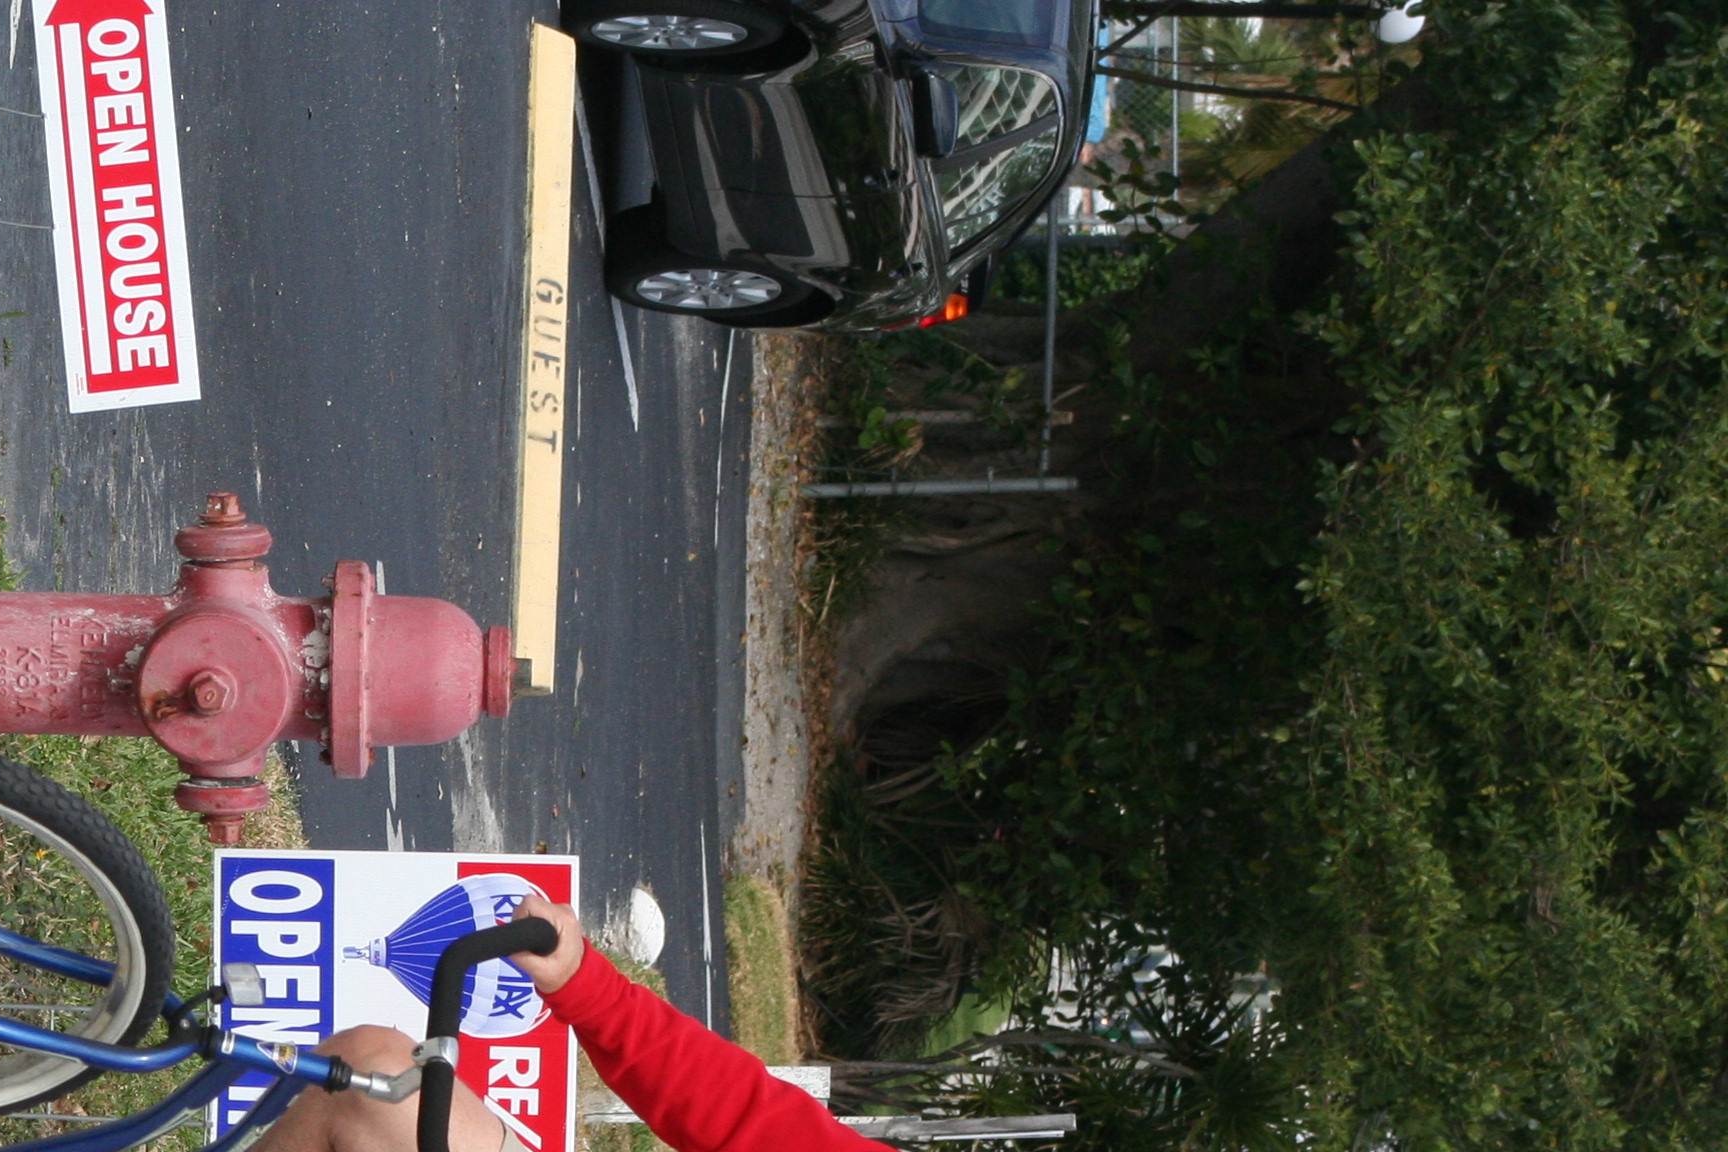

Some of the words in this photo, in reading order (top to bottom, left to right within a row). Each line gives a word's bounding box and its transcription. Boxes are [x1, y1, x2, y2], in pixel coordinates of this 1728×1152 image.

[87, 18, 150, 167] OPEN
[101, 183, 170, 373] HOUSE
[527, 278, 564, 454] GUEST
[15, 646, 43, 717] K-81A
[229, 869, 323, 1046] OPEN
